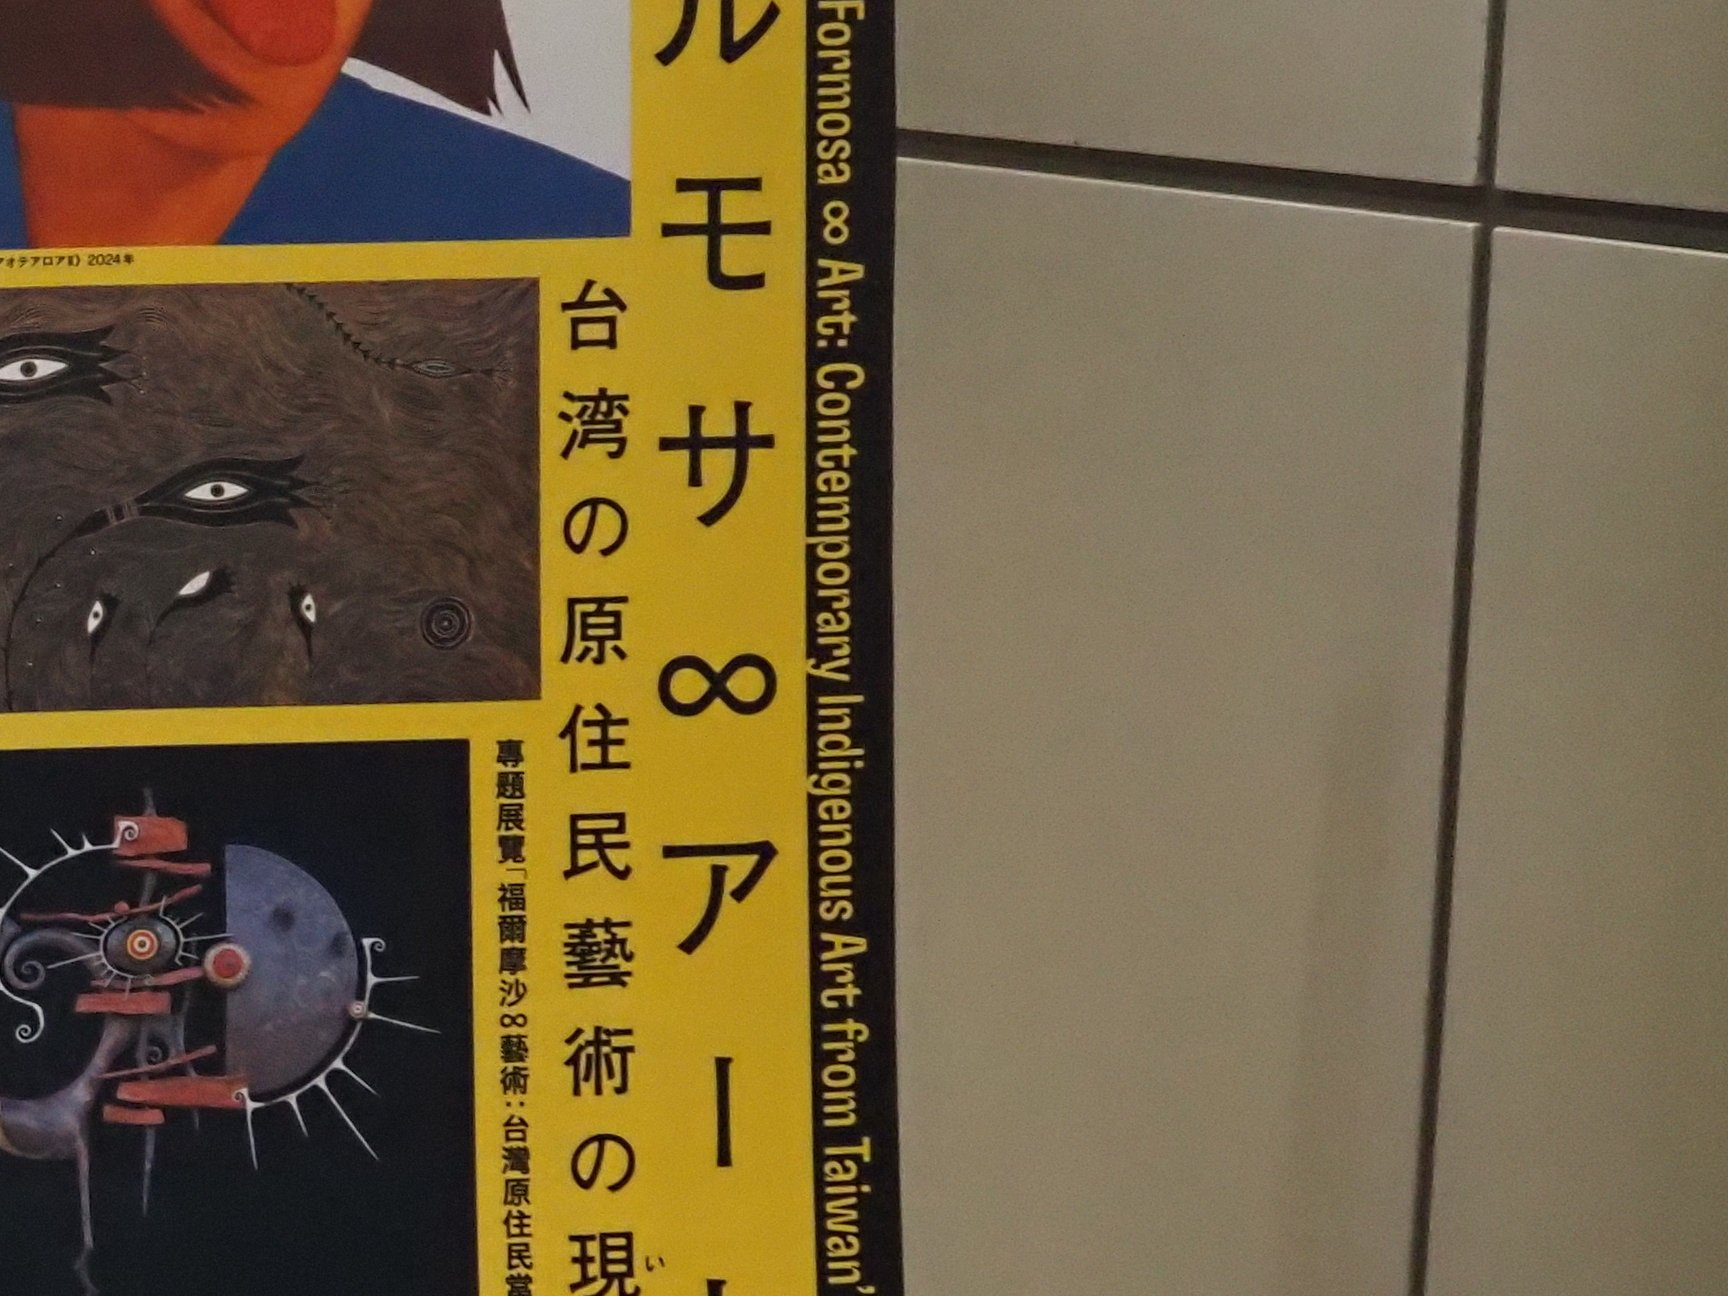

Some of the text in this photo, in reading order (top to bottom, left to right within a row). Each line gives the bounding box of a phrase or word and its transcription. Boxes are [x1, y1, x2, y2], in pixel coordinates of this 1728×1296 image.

[816, 258, 866, 348] Art:
[806, 362, 866, 682] Contemporary
[807, 694, 866, 922] Indigenous
[819, 931, 869, 1008] Art
[821, 1018, 870, 1128] from
